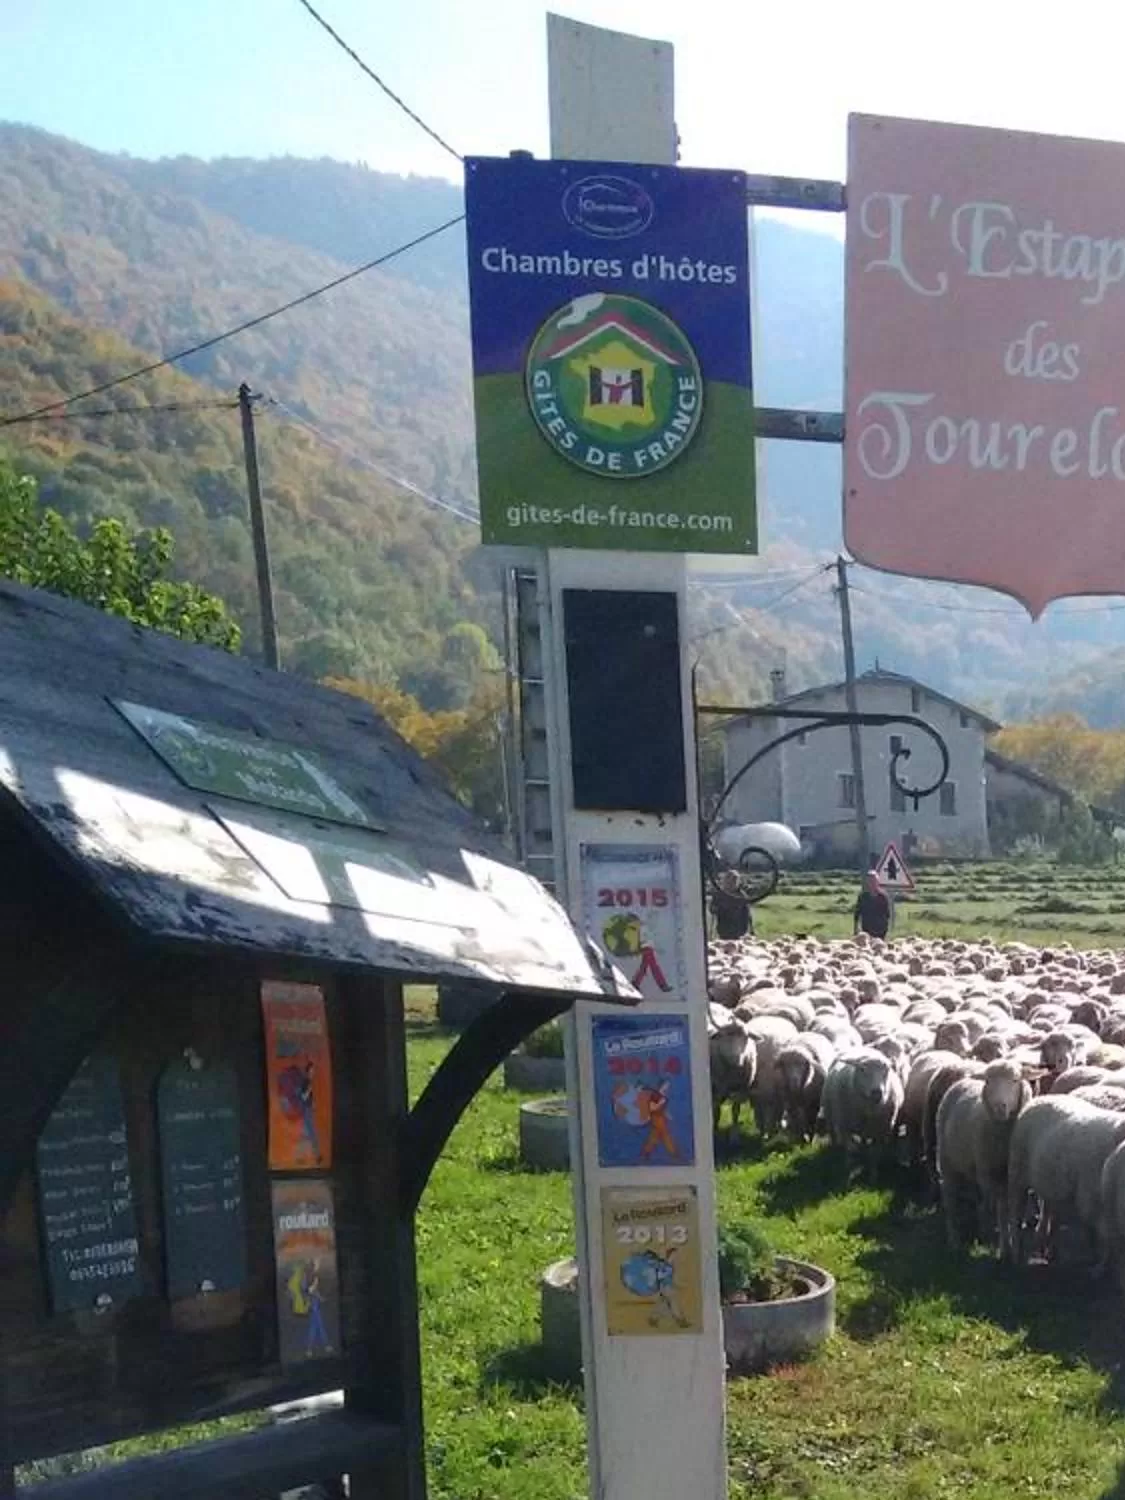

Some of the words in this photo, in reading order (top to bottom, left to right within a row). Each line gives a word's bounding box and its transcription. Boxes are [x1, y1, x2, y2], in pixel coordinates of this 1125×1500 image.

[481, 247, 624, 280] Chambres
[632, 254, 738, 285] d'hôtes
[1004, 320, 1081, 381] des
[585, 446, 622, 471] DE
[634, 374, 698, 470] FRANCE
[506, 503, 734, 533] gites-de-france.com
[597, 888, 669, 908] 2015
[279, 1208, 330, 1230] routard
[615, 1224, 689, 1246] 2013
